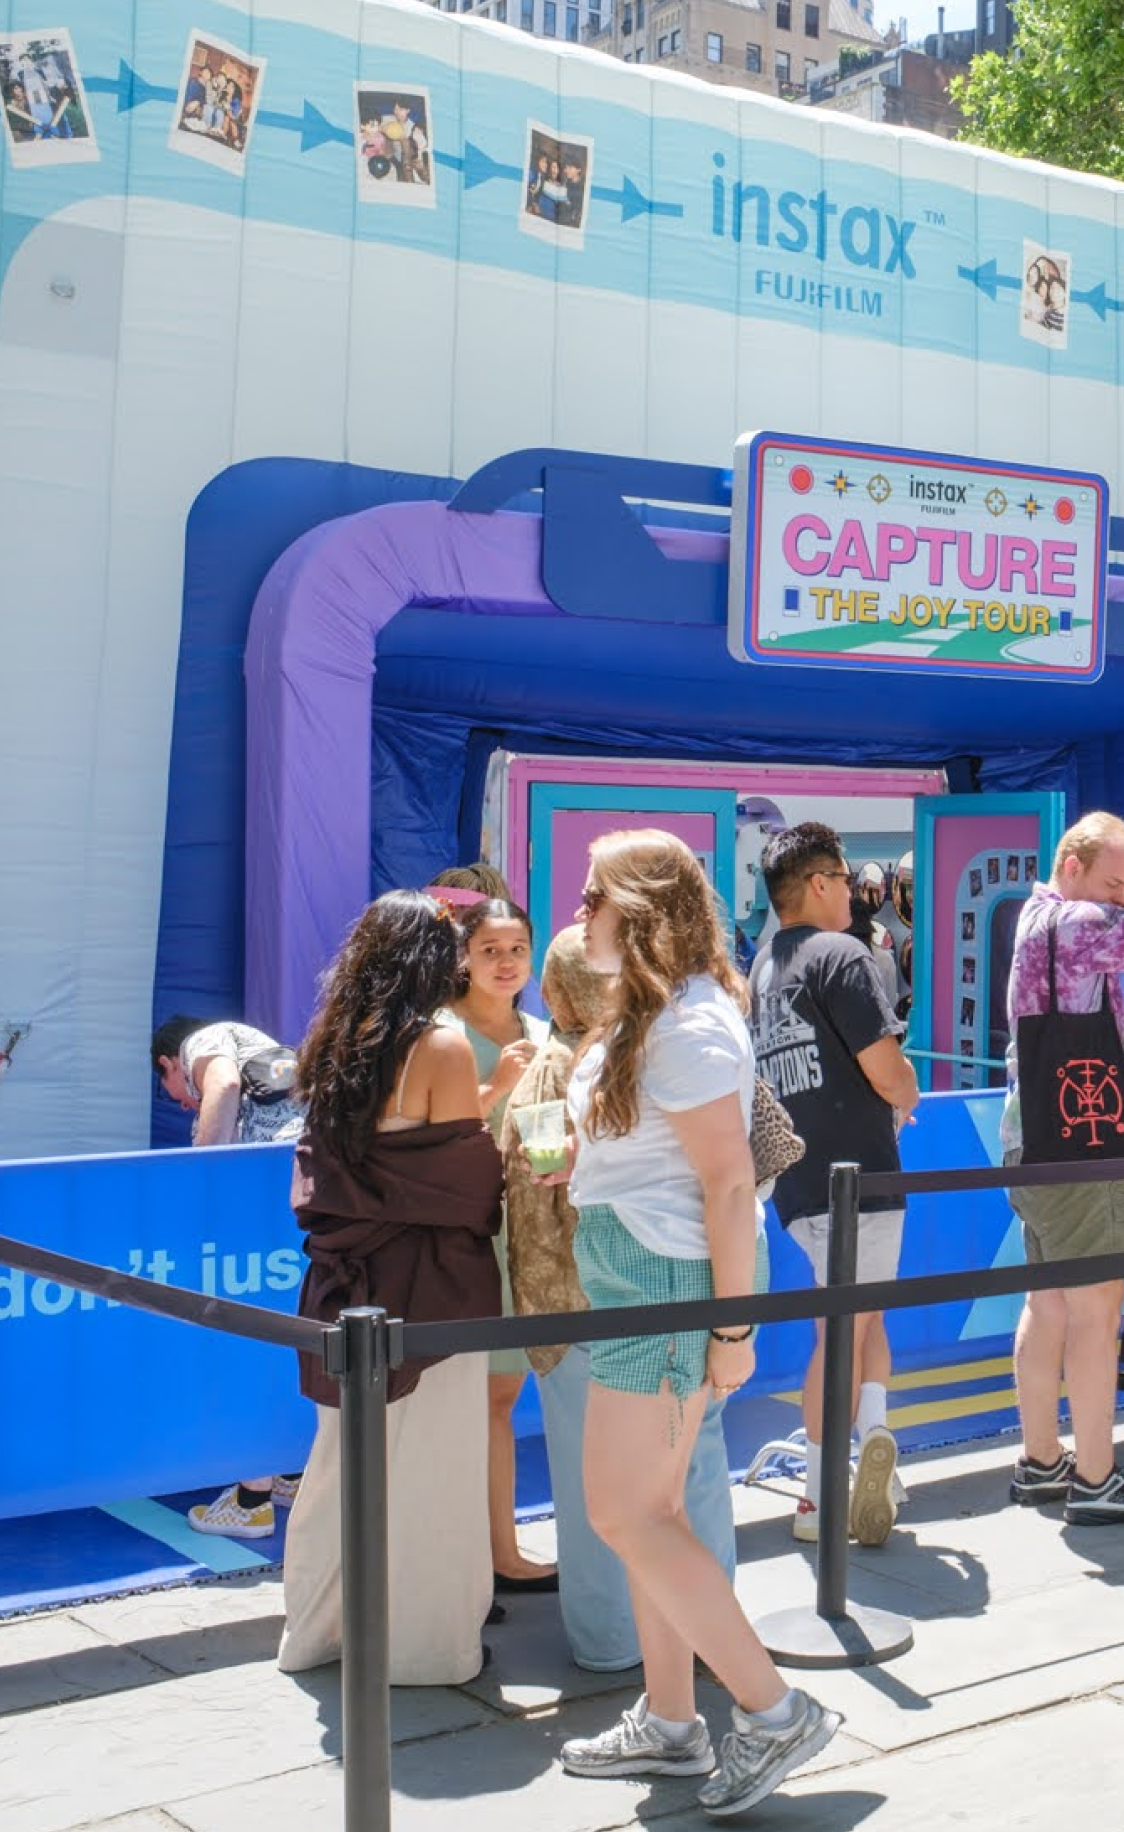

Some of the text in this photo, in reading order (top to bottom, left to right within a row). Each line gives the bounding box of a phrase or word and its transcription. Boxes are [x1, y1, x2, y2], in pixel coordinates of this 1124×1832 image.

[713, 152, 916, 279] instax
[756, 269, 882, 317] FUJIFILM
[909, 474, 967, 503] instax
[920, 504, 956, 516] FUJIFILM
[782, 513, 1078, 597] CAPTURE
[809, 586, 1051, 636] THE JOY TOUR
[201, 1242, 301, 1297] jus
